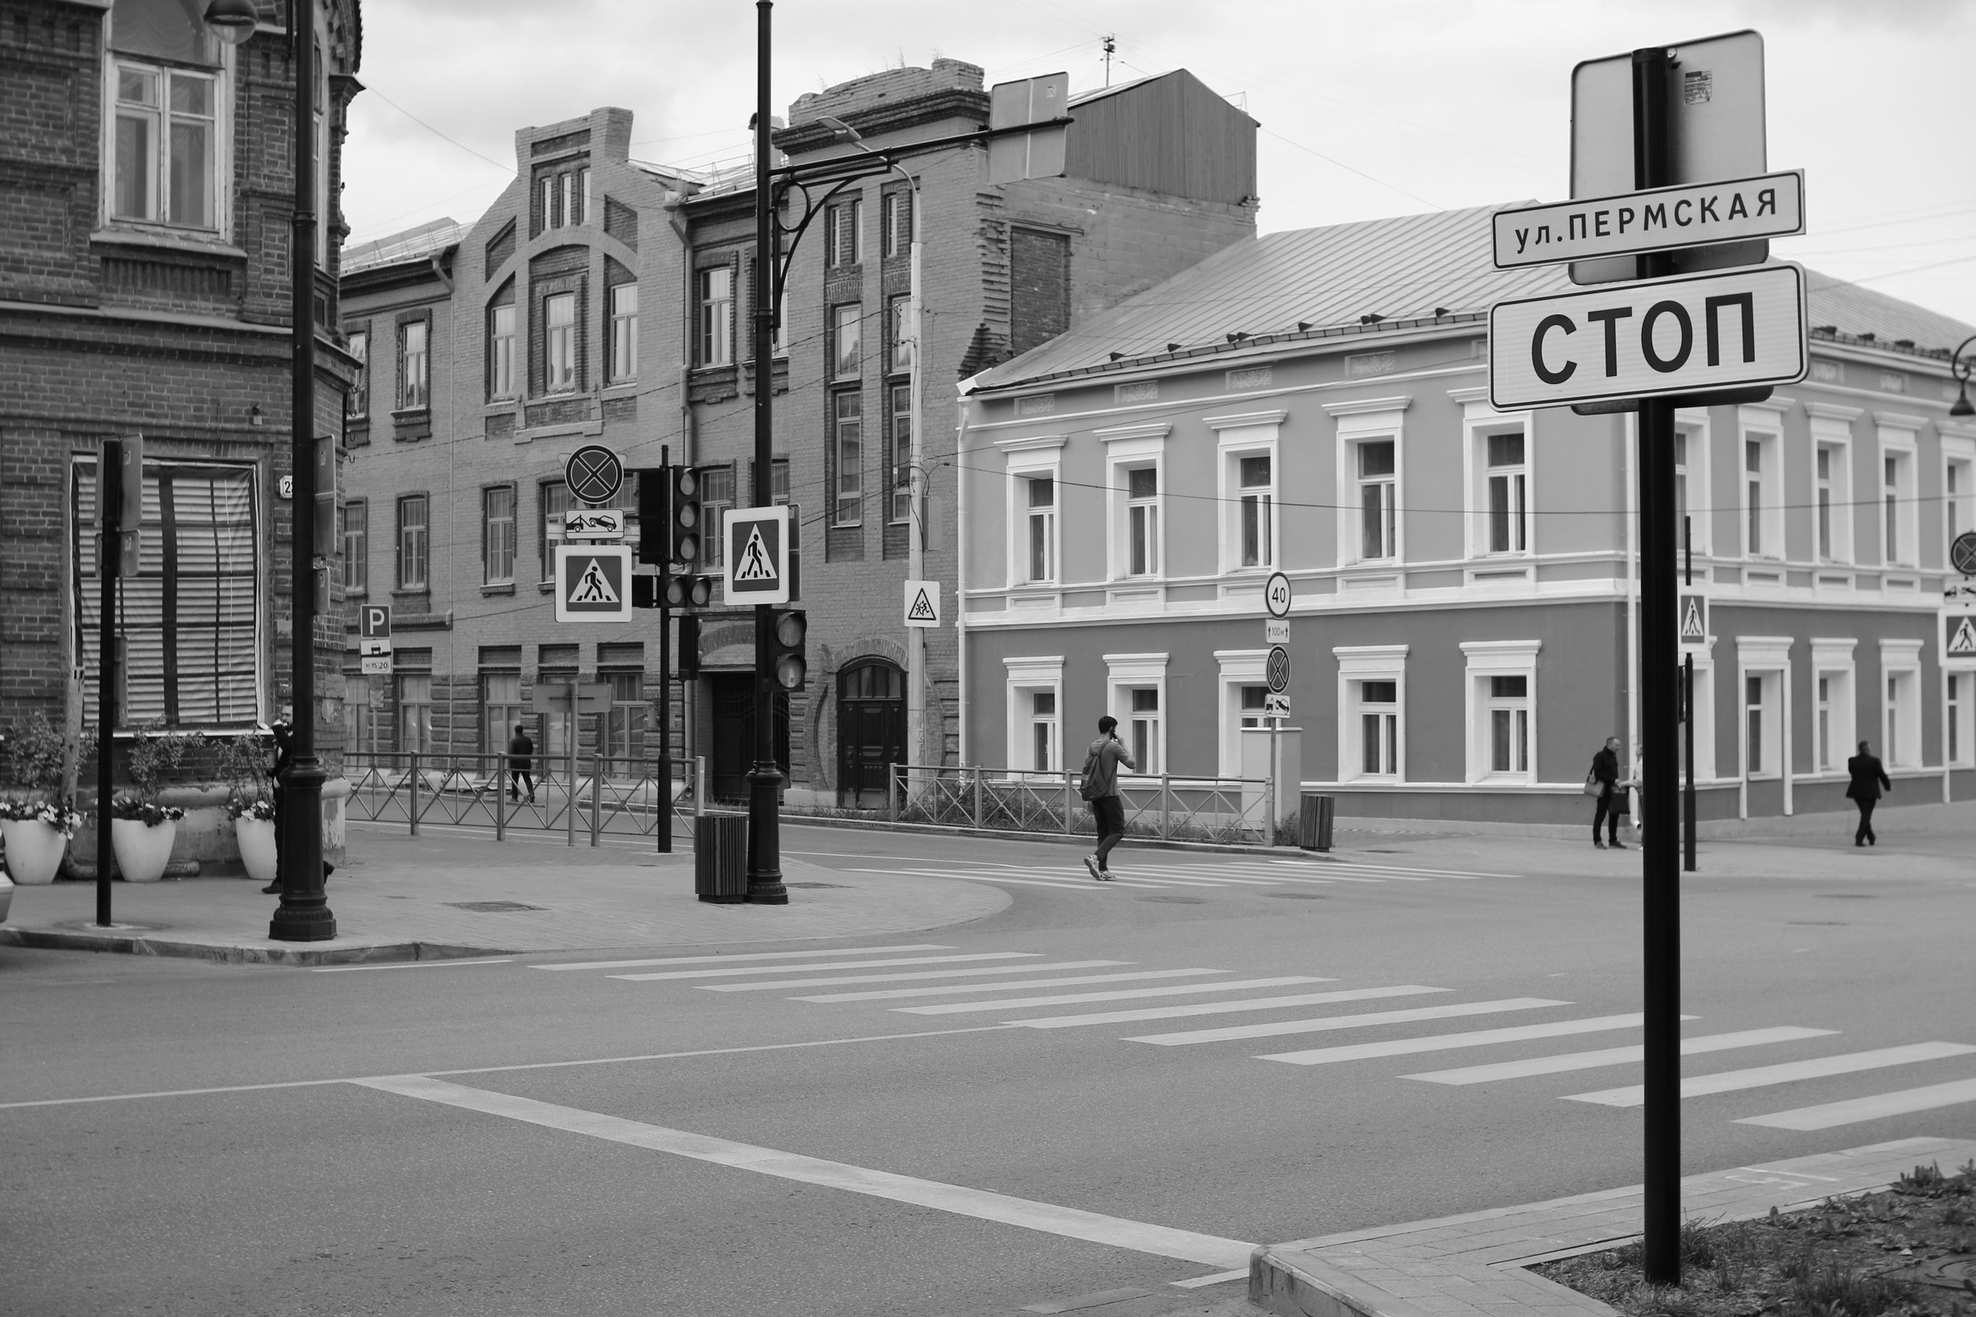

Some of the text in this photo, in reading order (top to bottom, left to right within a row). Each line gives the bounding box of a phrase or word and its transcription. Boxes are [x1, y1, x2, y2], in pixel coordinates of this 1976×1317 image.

[1531, 291, 1756, 386] СТОП
[1272, 587, 1286, 603] 40
[369, 608, 385, 635] P
